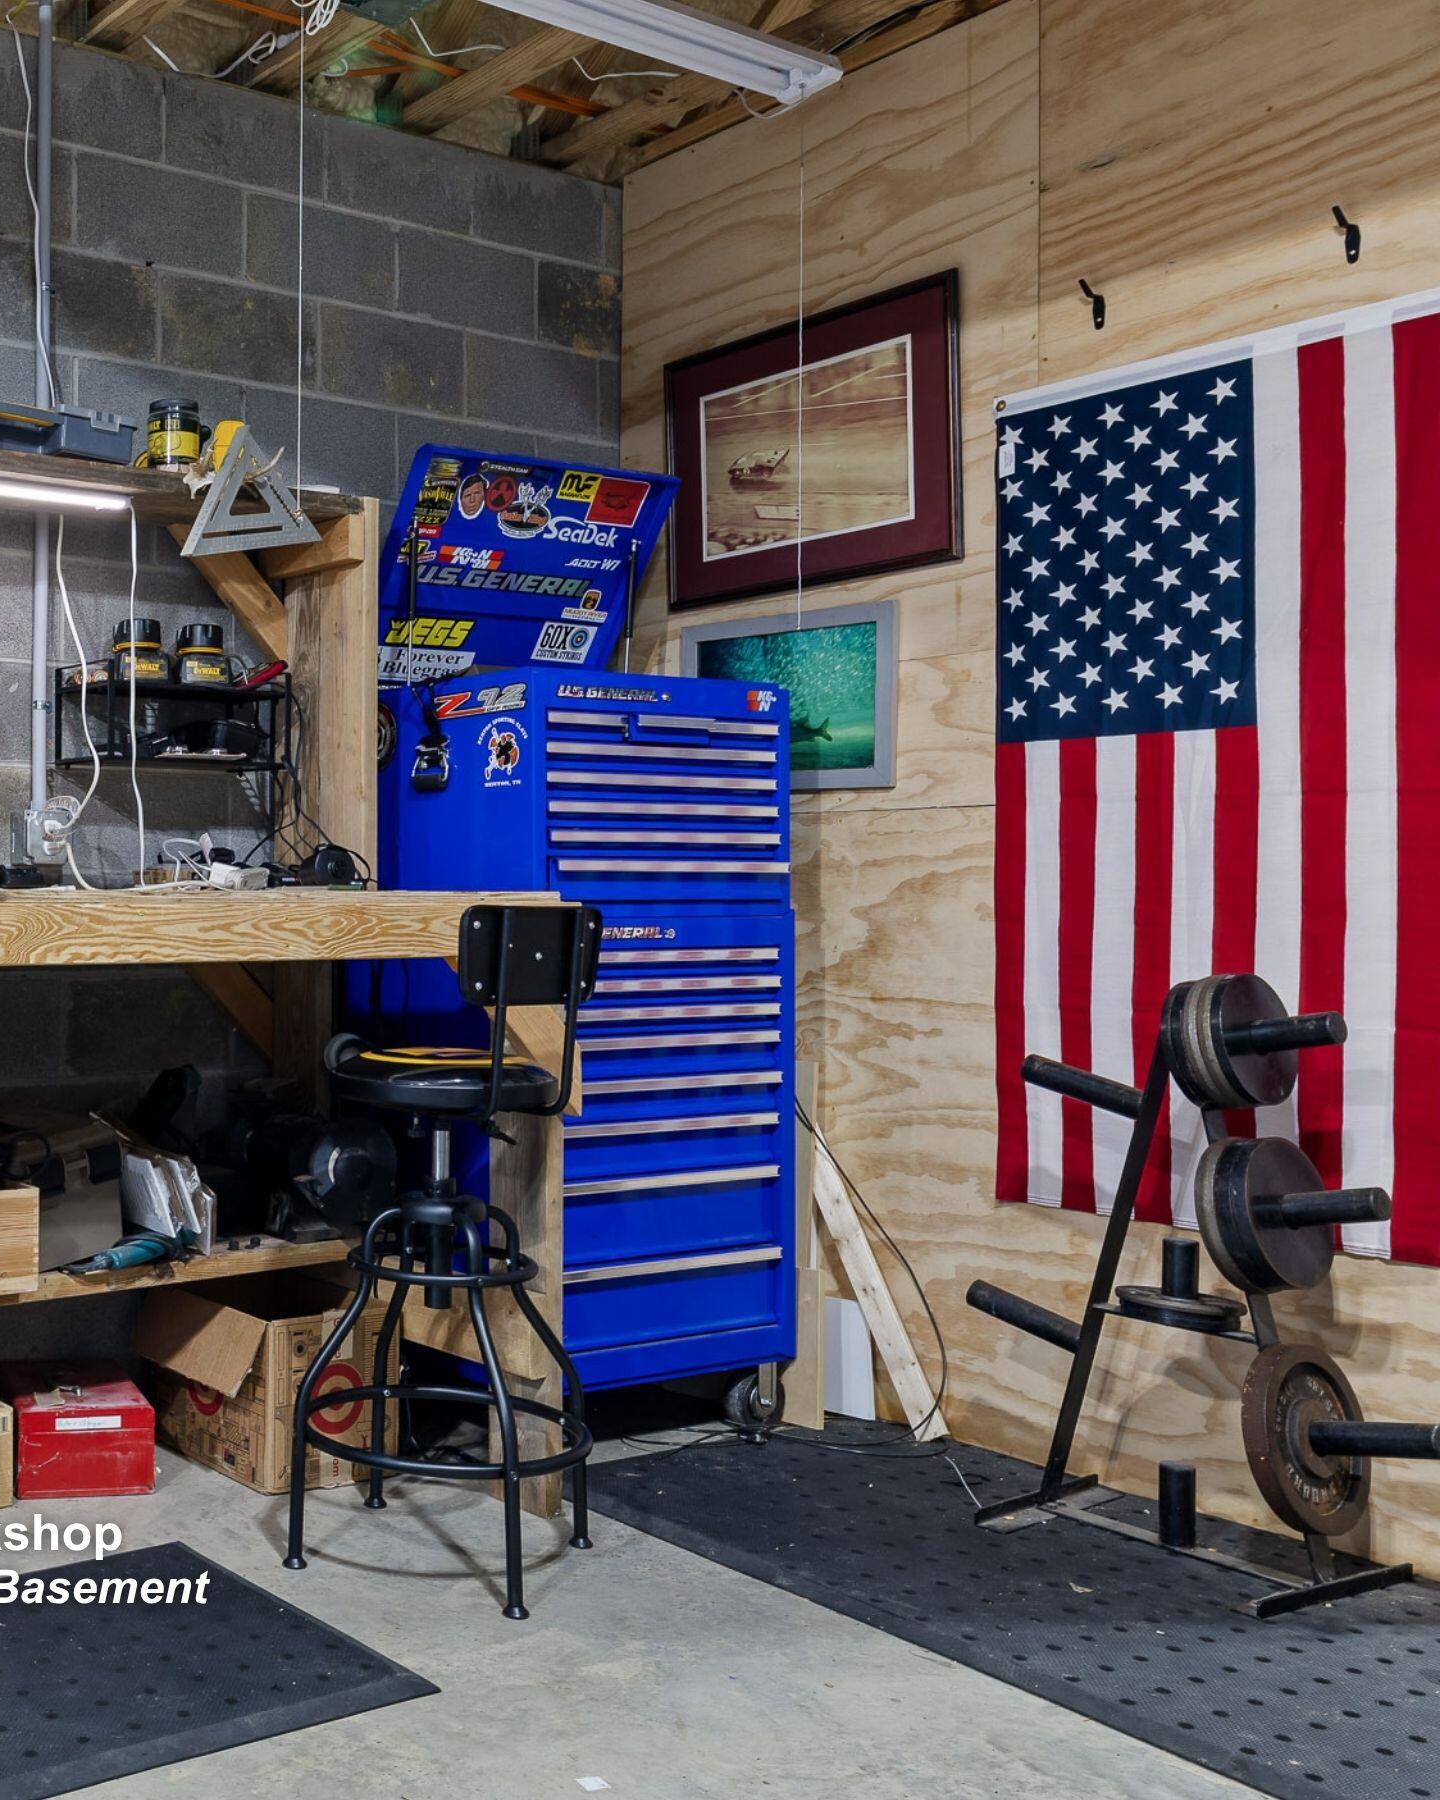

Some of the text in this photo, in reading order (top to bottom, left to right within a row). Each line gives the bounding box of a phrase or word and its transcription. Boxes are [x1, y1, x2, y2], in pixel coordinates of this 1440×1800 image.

[542, 516, 619, 548] SeaDek
[416, 566, 590, 598] U.S. GENERAL
[385, 617, 475, 648] JEGS
[393, 648, 465, 665] Forever
[382, 661, 460, 679] Bluegras
[601, 926, 663, 940] ENERAL
